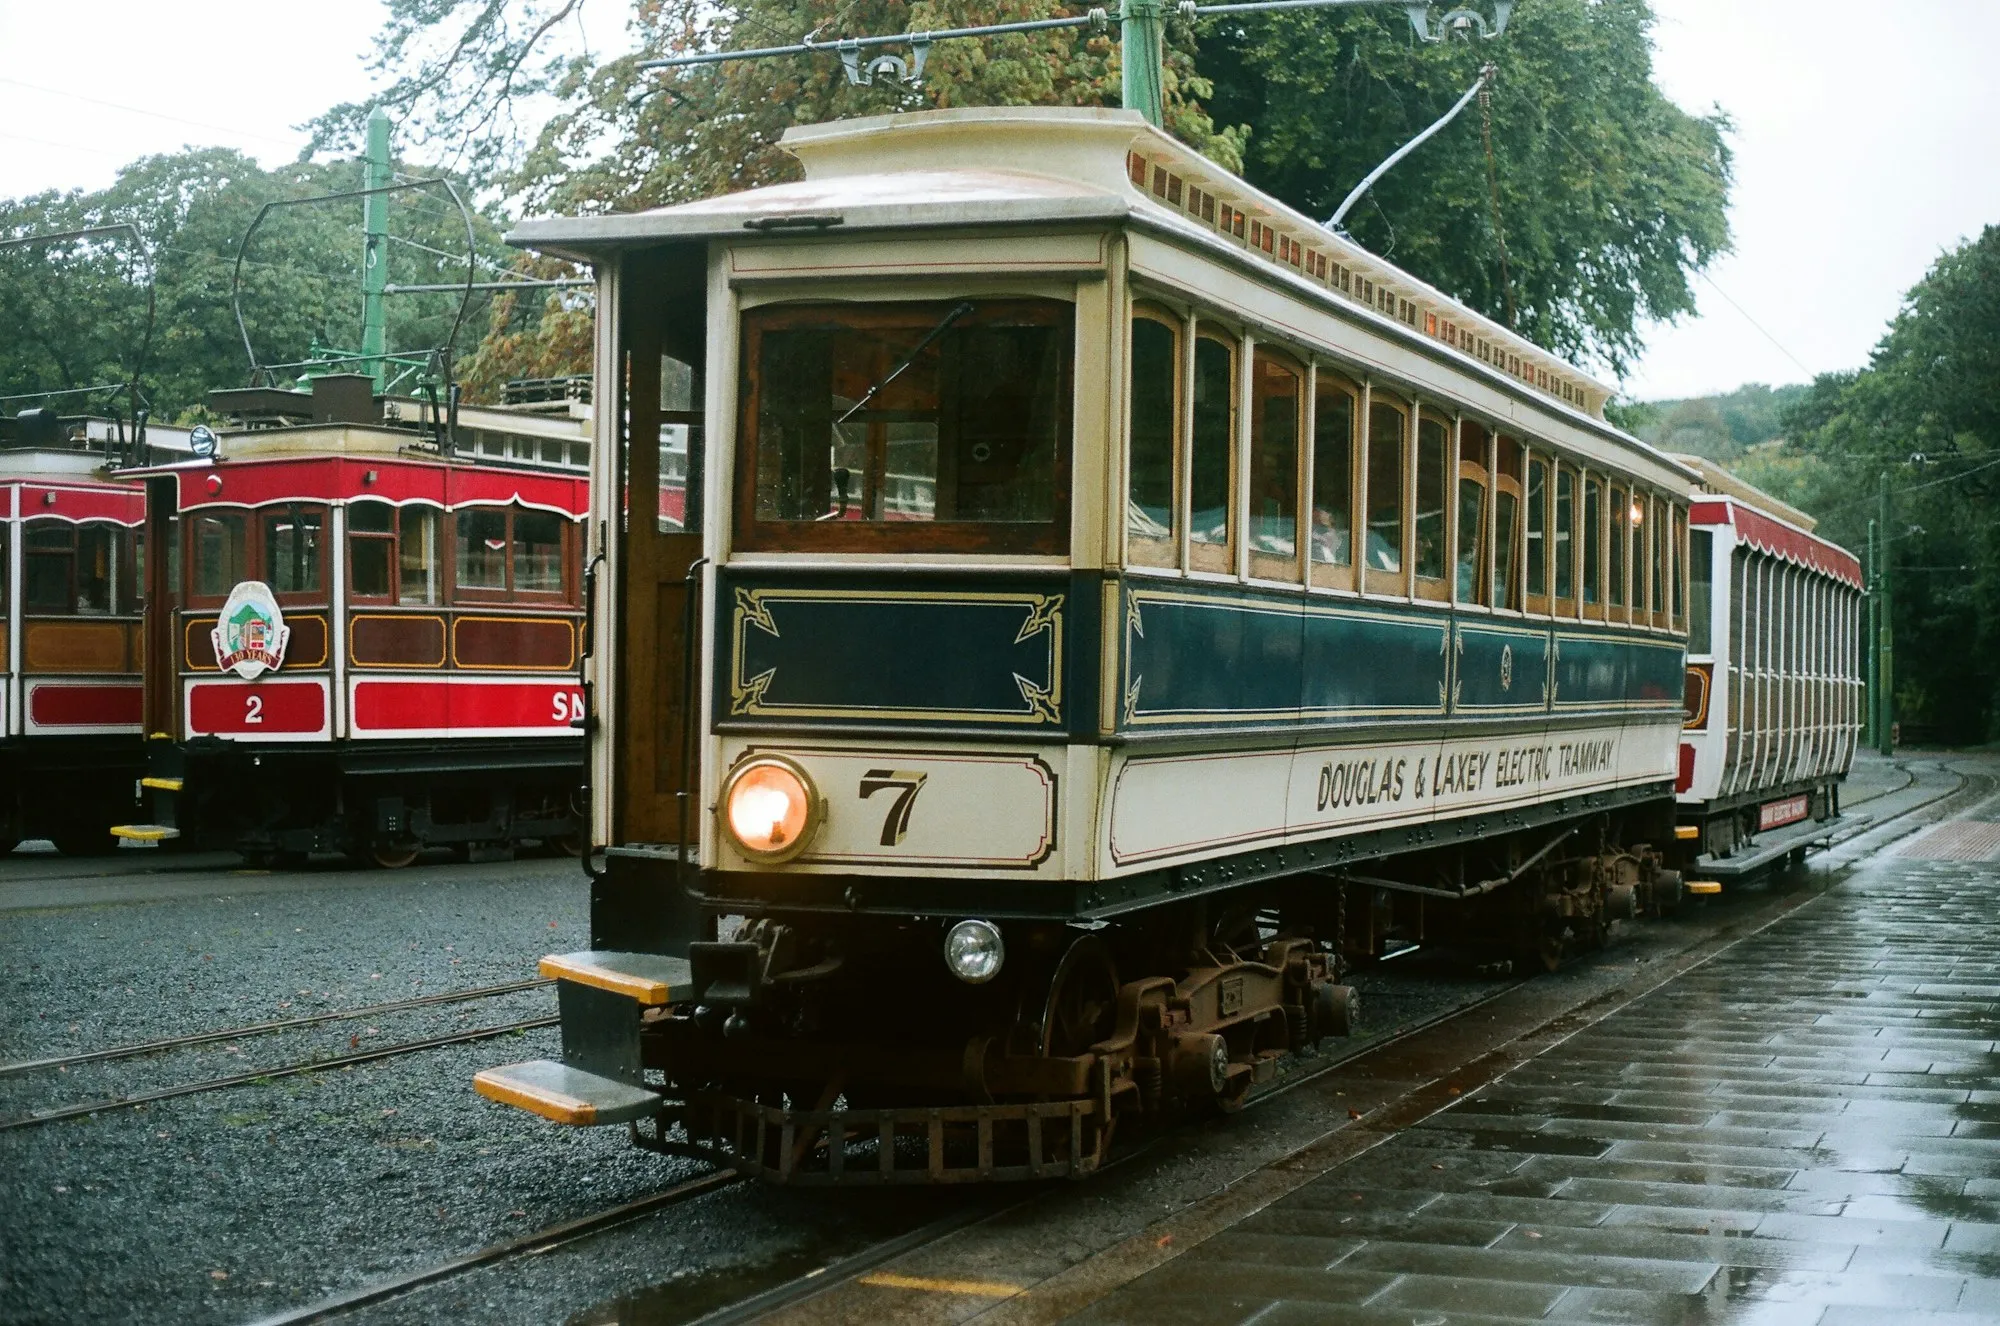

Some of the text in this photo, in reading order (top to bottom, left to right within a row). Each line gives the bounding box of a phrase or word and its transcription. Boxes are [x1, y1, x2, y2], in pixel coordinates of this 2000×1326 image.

[244, 695, 263, 724] 2
[859, 769, 928, 846] 7
[1317, 756, 1407, 812] DOUGLAS
[1414, 754, 1426, 799] &
[1432, 750, 1490, 797] LAXEY
[1496, 745, 1552, 788] ELECTRIC
